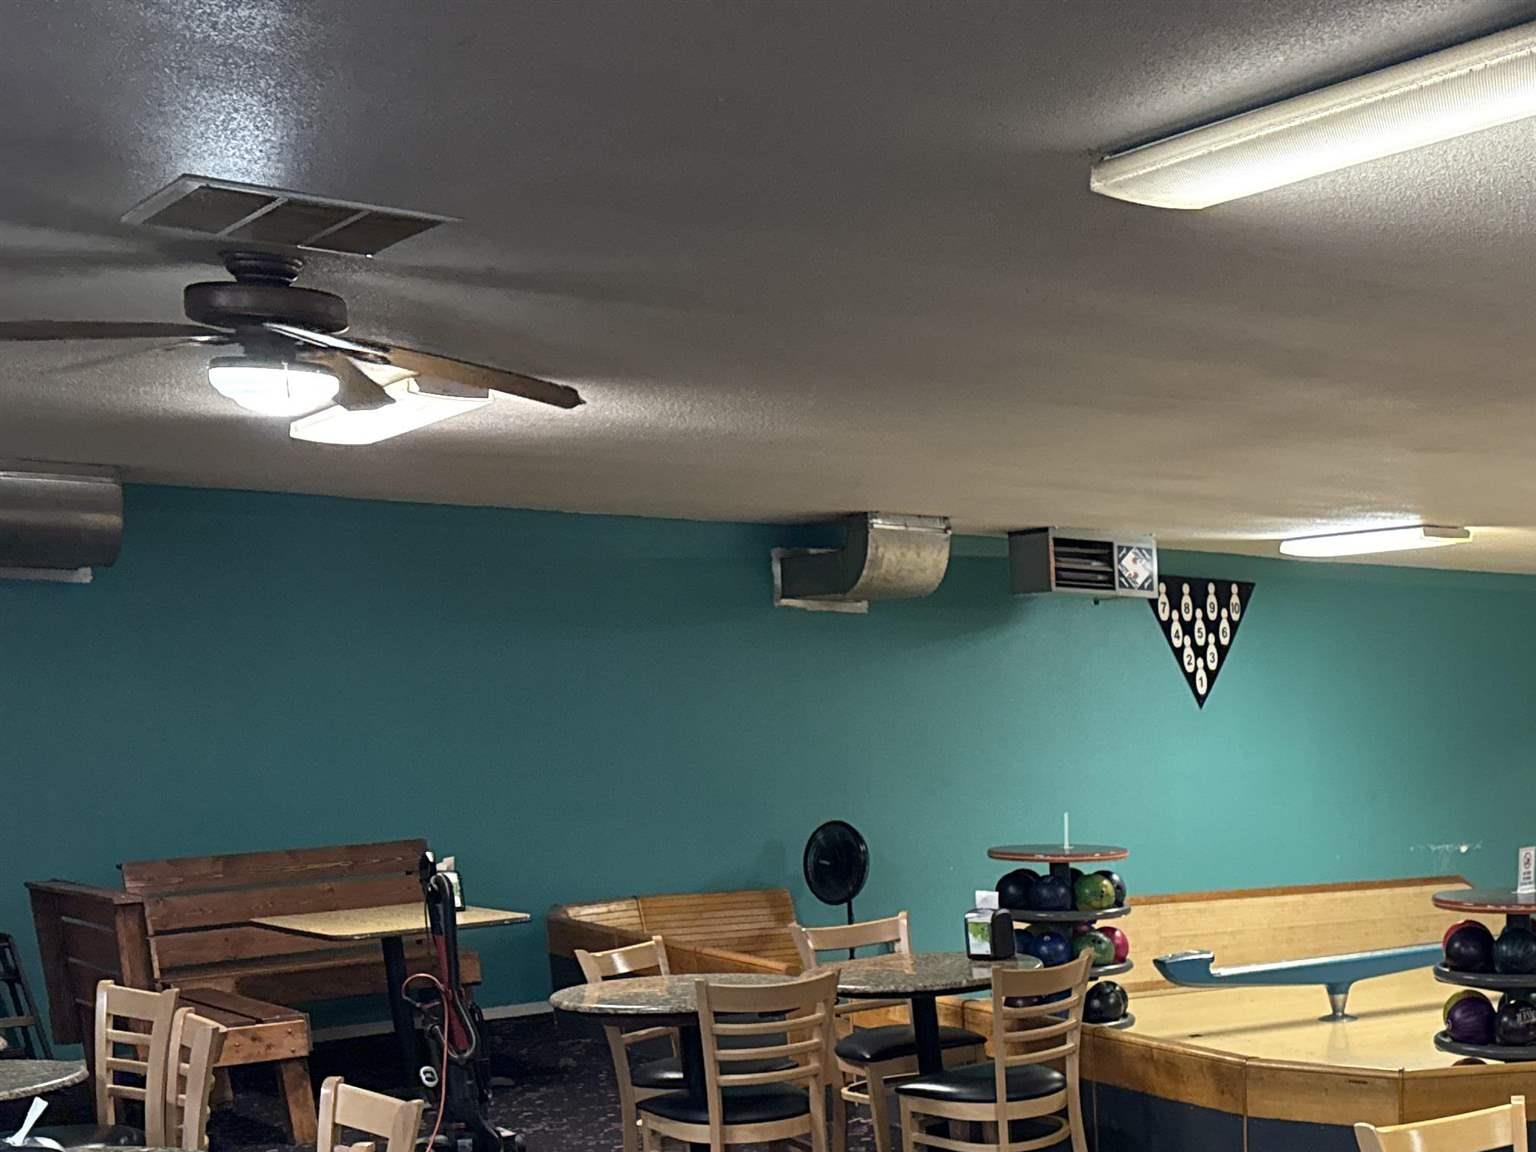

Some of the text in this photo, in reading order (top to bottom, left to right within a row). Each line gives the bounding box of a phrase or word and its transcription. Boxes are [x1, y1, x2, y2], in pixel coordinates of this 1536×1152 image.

[1160, 601, 1240, 615] 7 8 9 10
[1174, 626, 1228, 641] 4 5 6
[1186, 652, 1216, 666] 2 3
